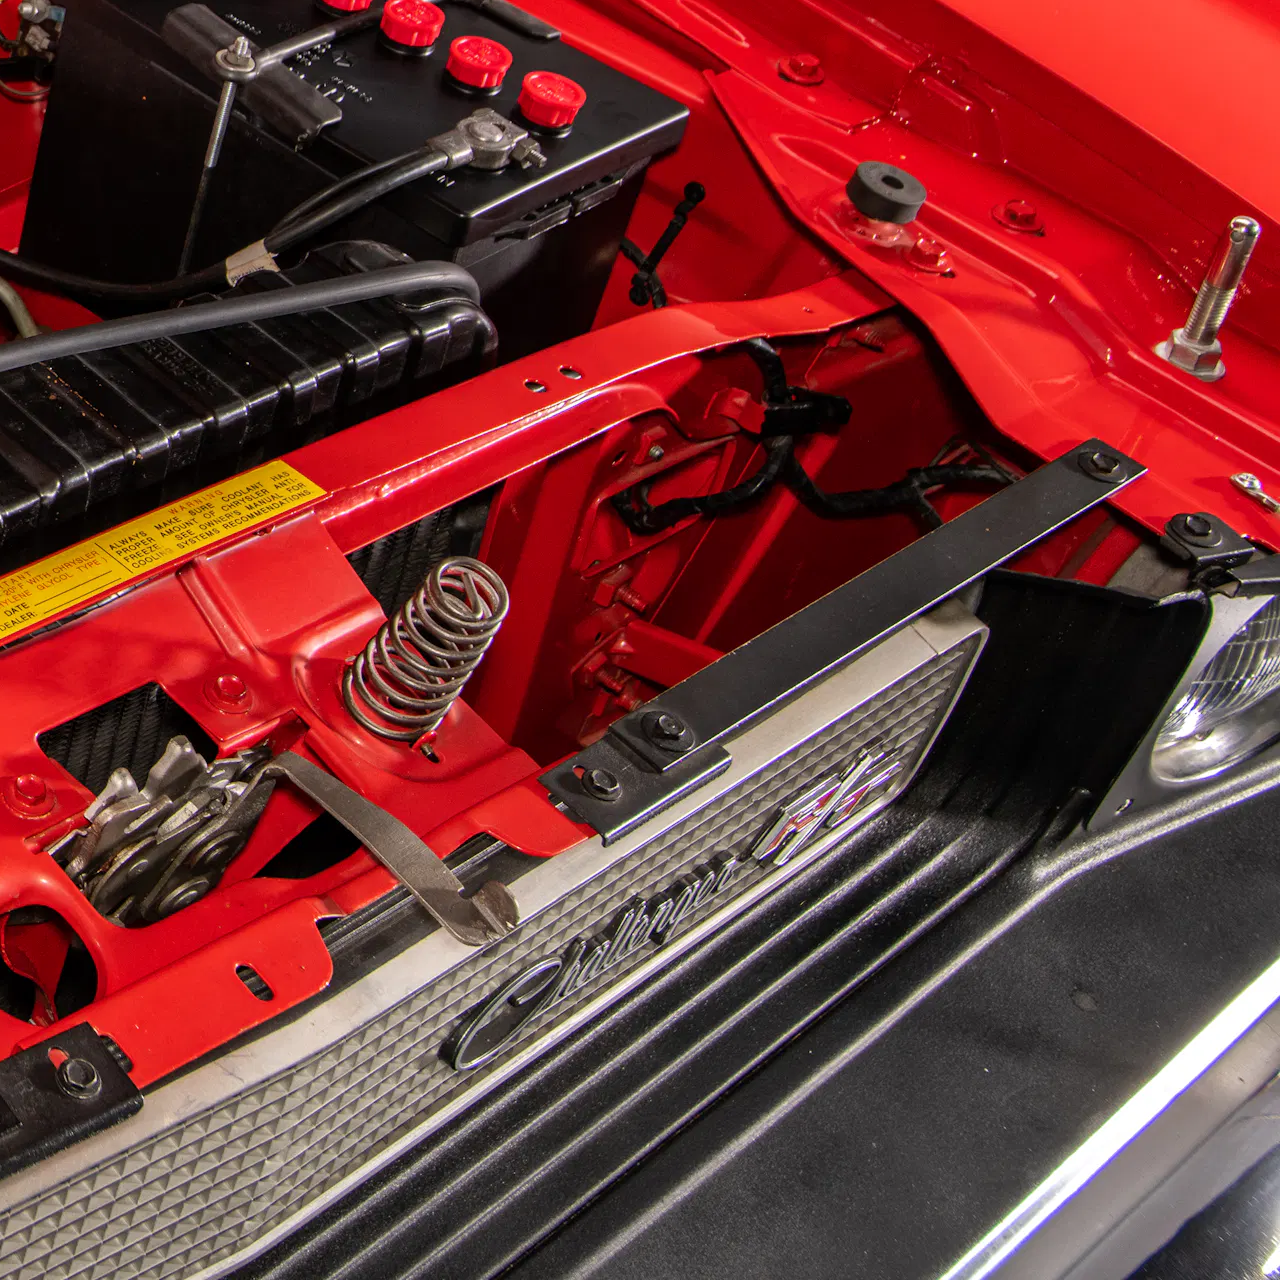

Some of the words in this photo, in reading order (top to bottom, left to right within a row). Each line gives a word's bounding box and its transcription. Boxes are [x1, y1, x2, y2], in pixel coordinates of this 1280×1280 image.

[109, 530, 148, 550] ALWAYS
[153, 516, 180, 530] MAKE
[188, 503, 215, 517] SURE
[221, 481, 264, 502] COOLANT
[270, 471, 291, 482] HAS
[168, 489, 224, 515] WARNING
[175, 529, 195, 541] SEE
[201, 510, 242, 531] OWNER'S
[246, 493, 284, 511] MANUAL
[287, 482, 307, 494] FOR
[116, 537, 155, 557] PROPER
[160, 517, 202, 538] AMOUNT
[203, 510, 216, 519] OF
[221, 489, 270, 511] CHRYSLER
[28, 570, 52, 586] WITH
[52, 550, 101, 579] CHRYSLER
[132, 548, 174, 569] COOLING
[177, 528, 221, 550] SYSTEMS
[36, 573, 73, 591] GLYCOL
[4, 602, 30, 617] DATE
[442, 851, 738, 1072] Challenger
